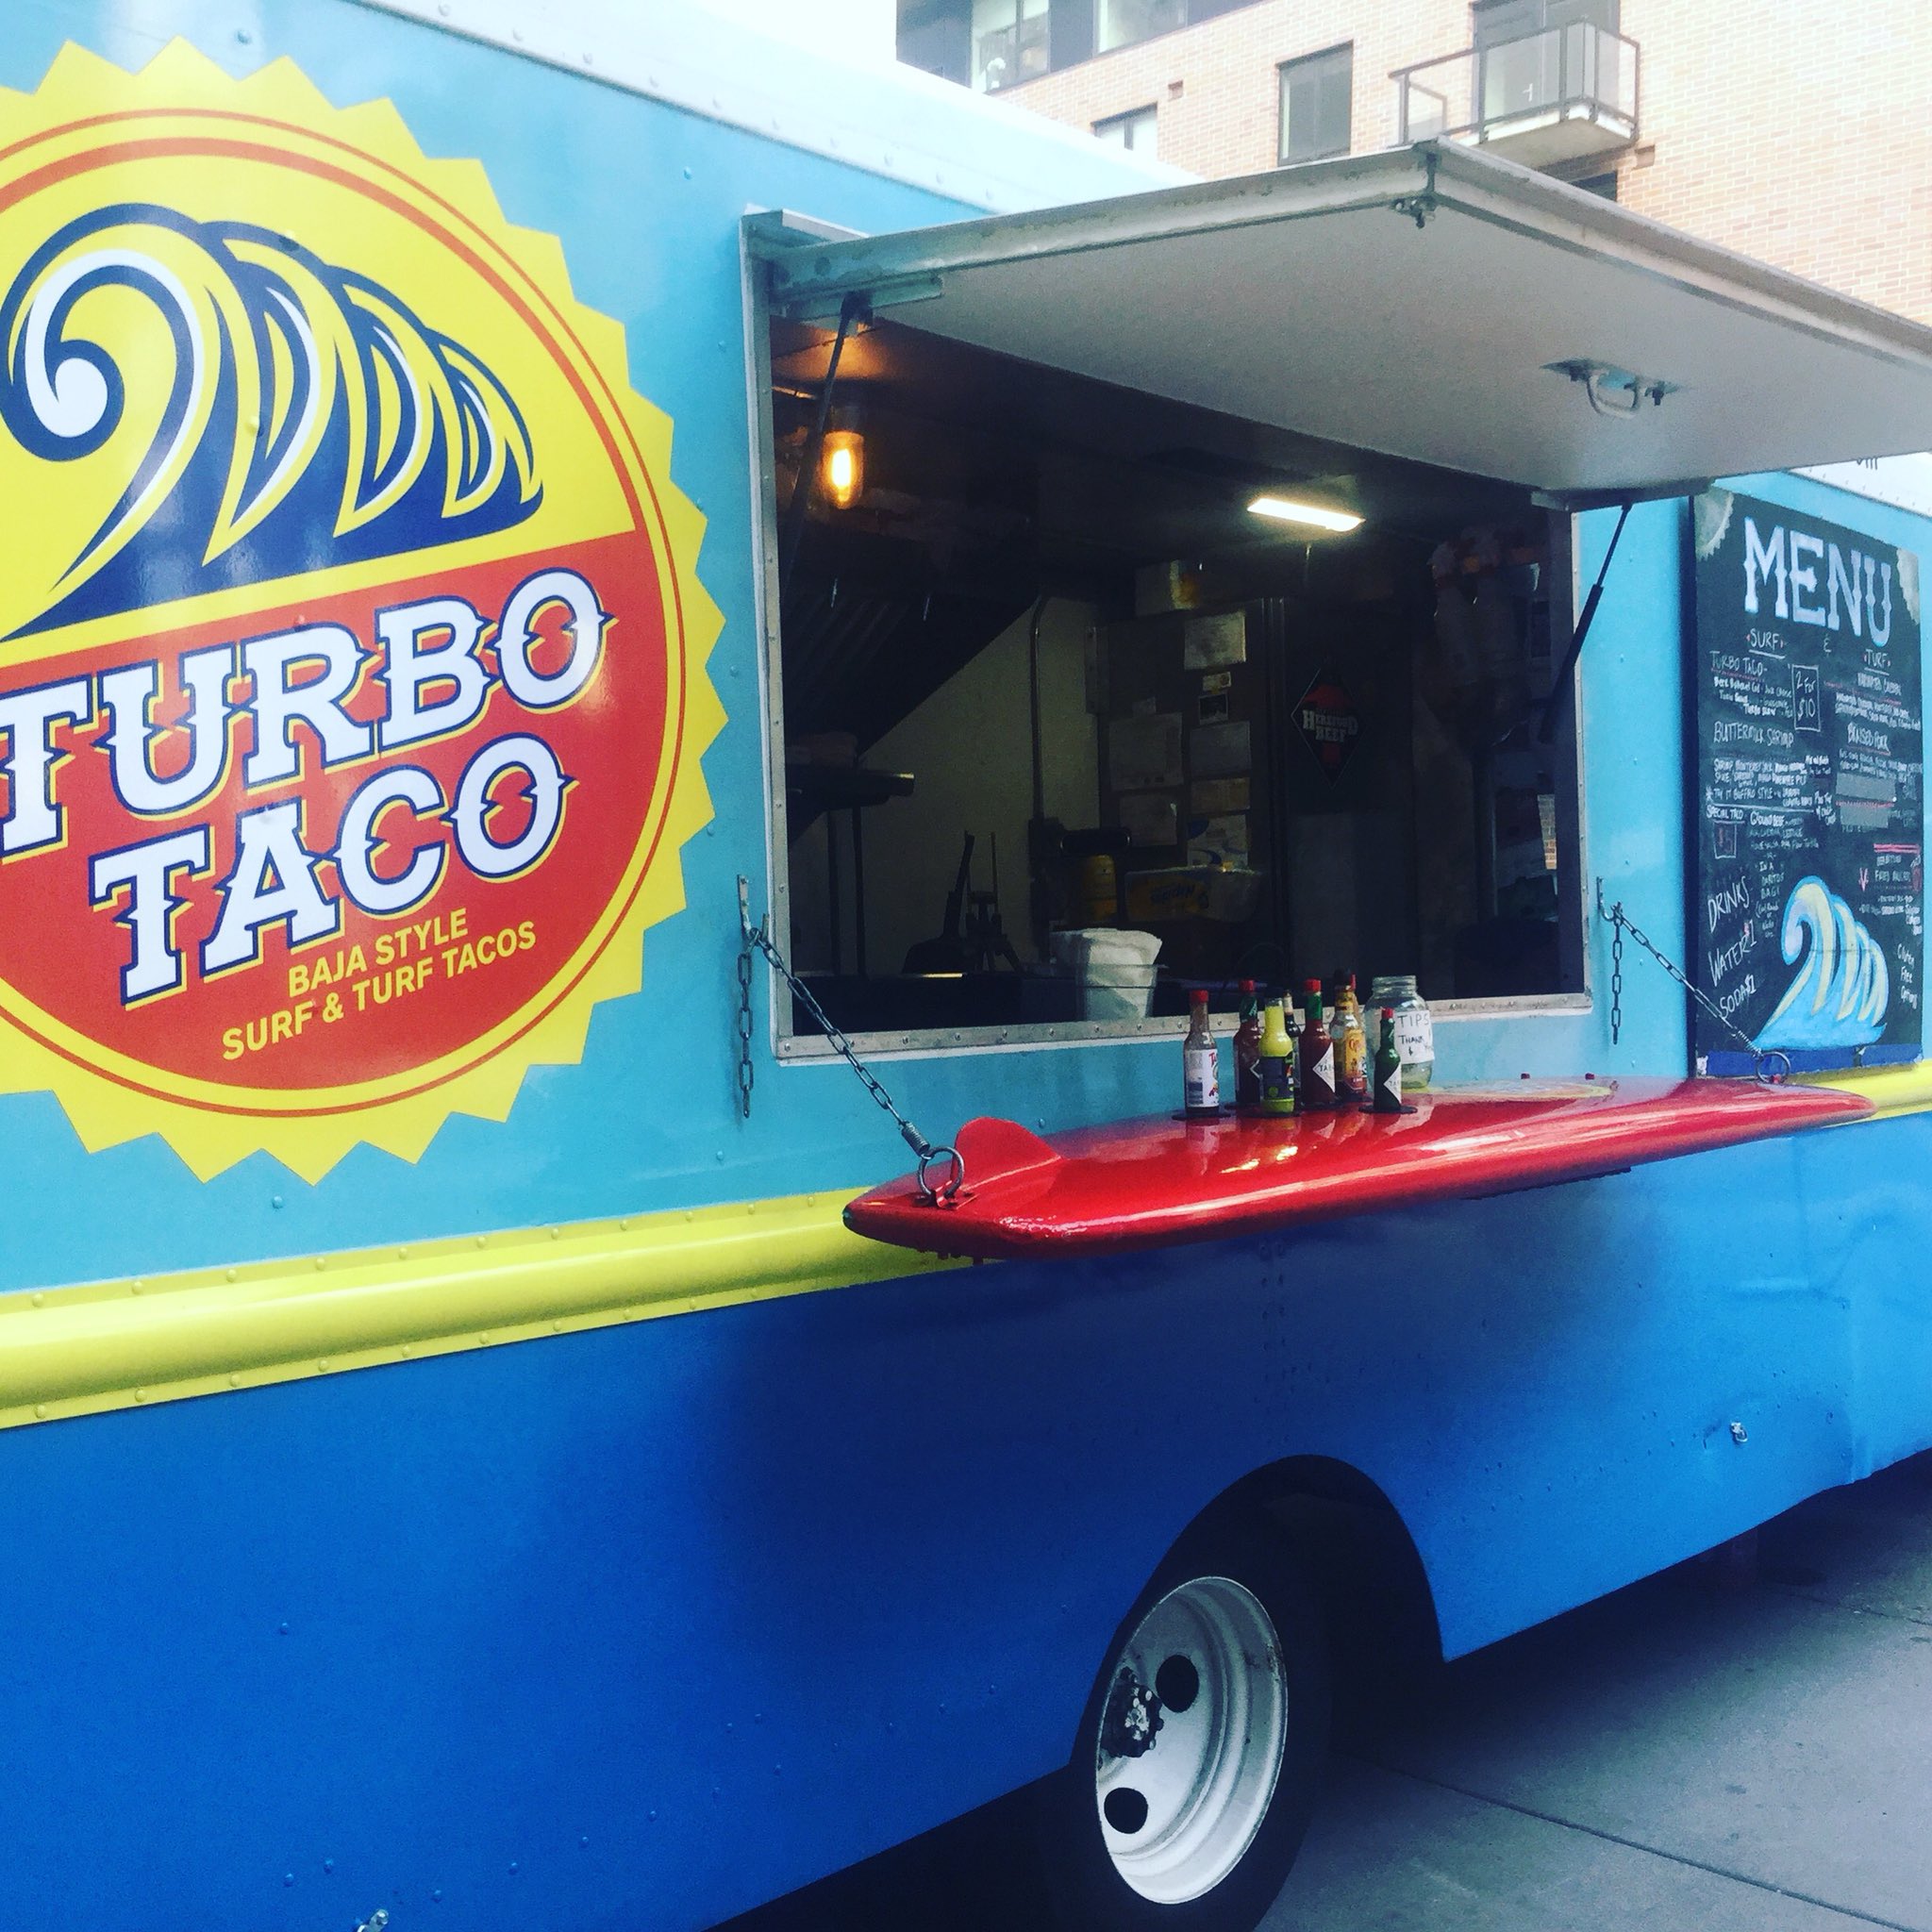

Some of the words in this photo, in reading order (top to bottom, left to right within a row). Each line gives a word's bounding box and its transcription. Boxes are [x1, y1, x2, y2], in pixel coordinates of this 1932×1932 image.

[1745, 517, 1891, 647] MENU
[1709, 650, 1740, 671] TURBO
[1750, 629, 1780, 650] SURF
[1865, 649, 1888, 668] TURF
[1795, 671, 1803, 690] 2
[0, 567, 619, 864] TURBO
[1797, 697, 1816, 721] $10
[1315, 725, 1347, 743] BEEF
[1707, 805, 1729, 819] SPECIAL
[89, 732, 578, 1008] TACO
[1707, 875, 1750, 933] DRINKS
[289, 945, 368, 998] BAJA
[375, 908, 469, 965] STYLE
[1708, 935, 1751, 987] WATER
[222, 1000, 314, 1061] SURF
[322, 992, 344, 1024] &
[352, 958, 434, 1012] TURF
[441, 920, 537, 979] TACOS
[1719, 983, 1749, 1019] SODA
[1397, 1013, 1429, 1028] TIPS
